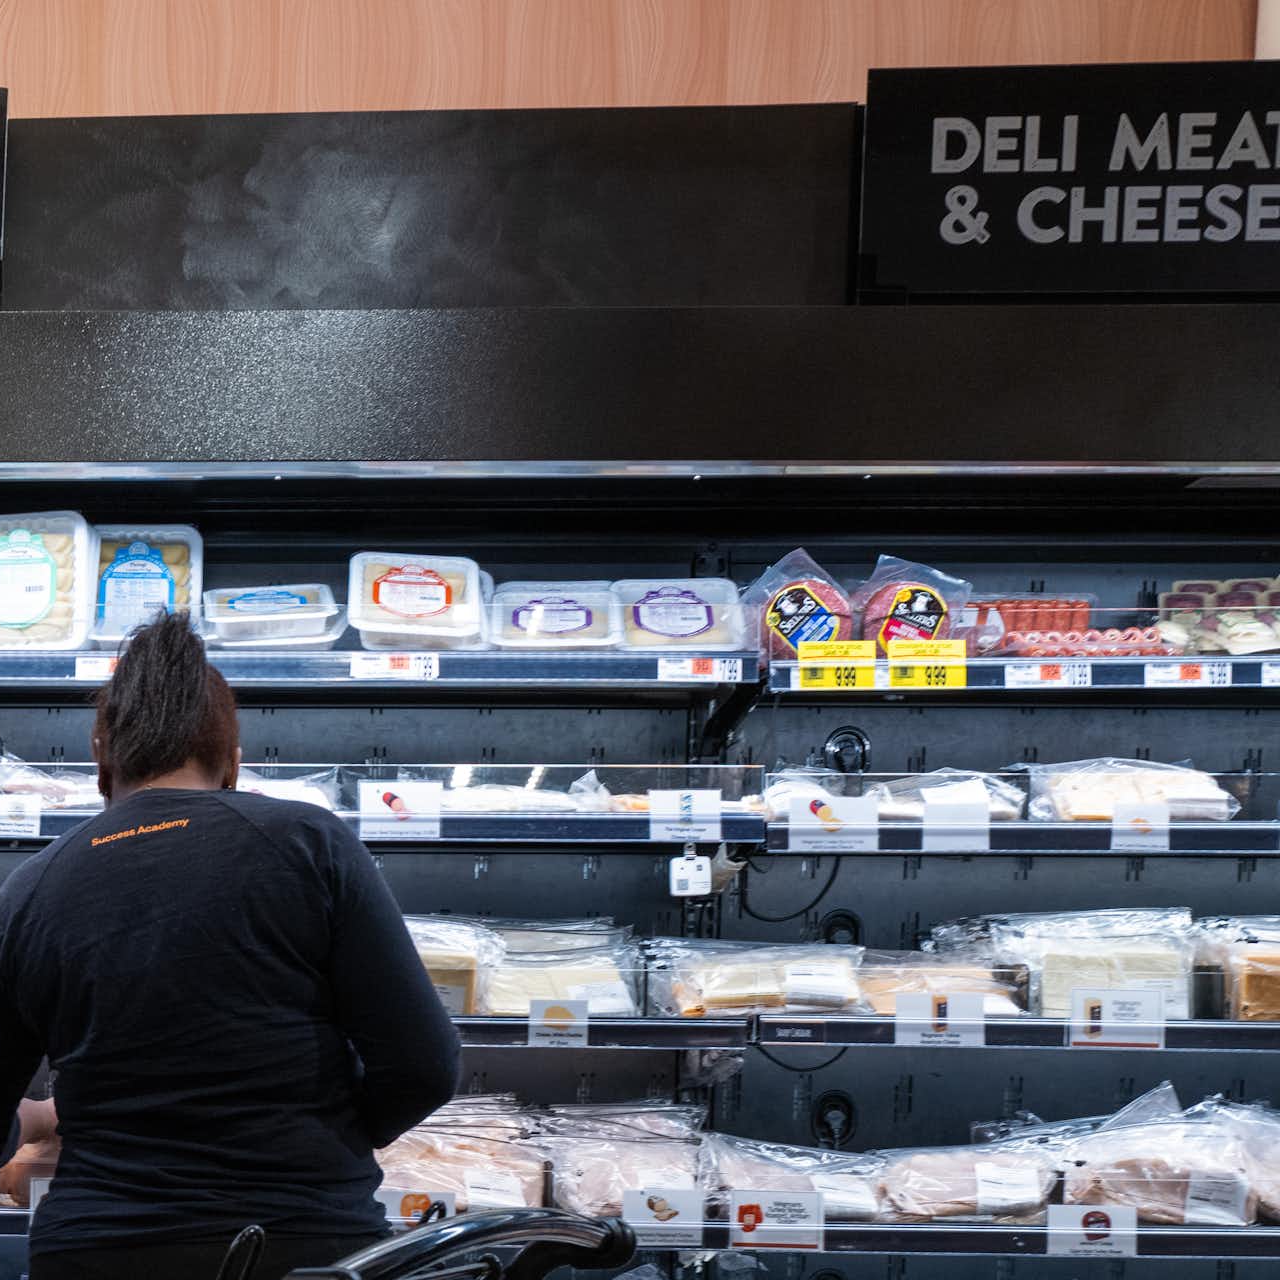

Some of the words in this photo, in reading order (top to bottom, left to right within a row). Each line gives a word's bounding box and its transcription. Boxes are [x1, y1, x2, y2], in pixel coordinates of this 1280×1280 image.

[931, 114, 1079, 174] DELI
[939, 184, 991, 245] &
[91, 828, 136, 847] Success
[137, 818, 189, 835] Academy
